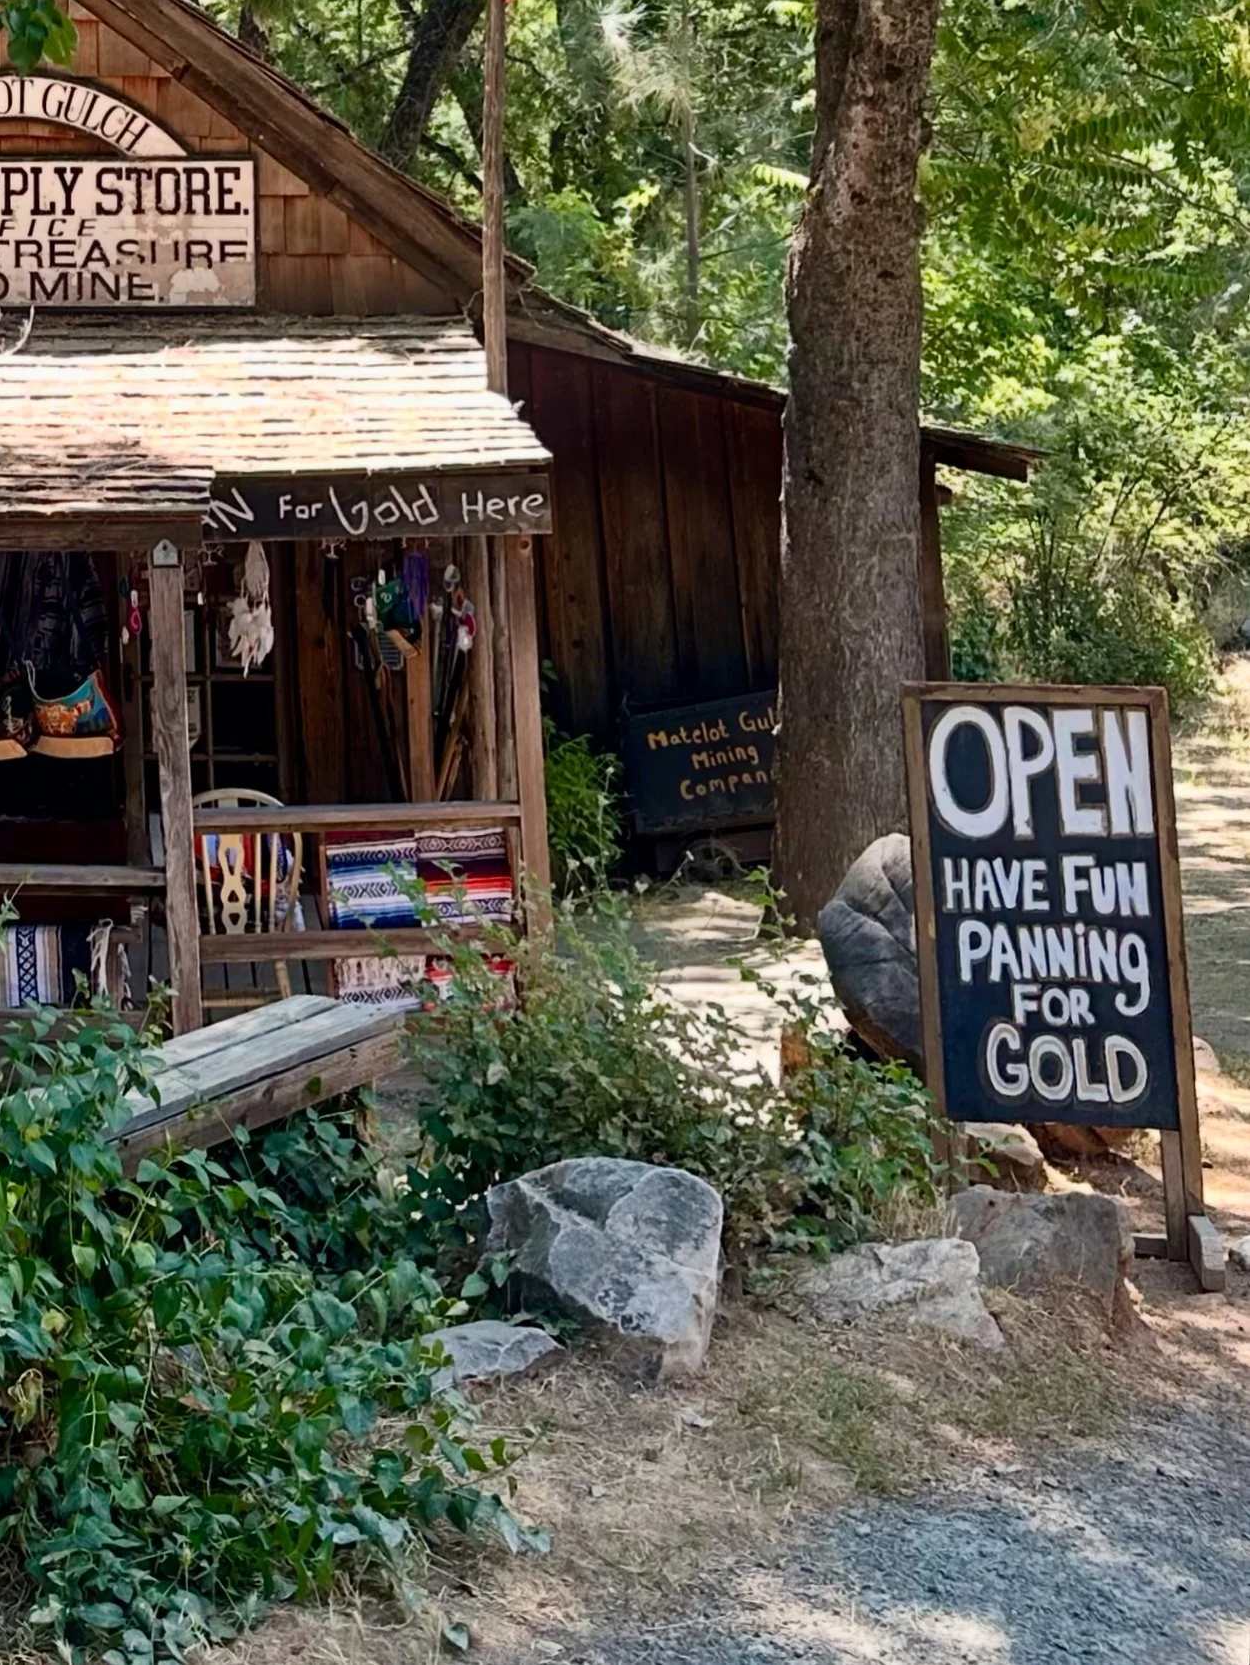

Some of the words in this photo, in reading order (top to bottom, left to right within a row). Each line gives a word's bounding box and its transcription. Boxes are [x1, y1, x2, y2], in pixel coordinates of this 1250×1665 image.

[41, 82, 150, 153] GULCH
[279, 494, 323, 520] For
[329, 484, 439, 535] Gold
[461, 489, 544, 524] Here
[647, 718, 730, 750] Matelot
[691, 745, 759, 770] Mining
[928, 705, 1153, 838] OPEN
[943, 857, 1048, 911] HAVE
[1062, 856, 1150, 917] FUN
[1012, 984, 1095, 1027] FOR
[985, 1023, 1148, 1104] GOLD
